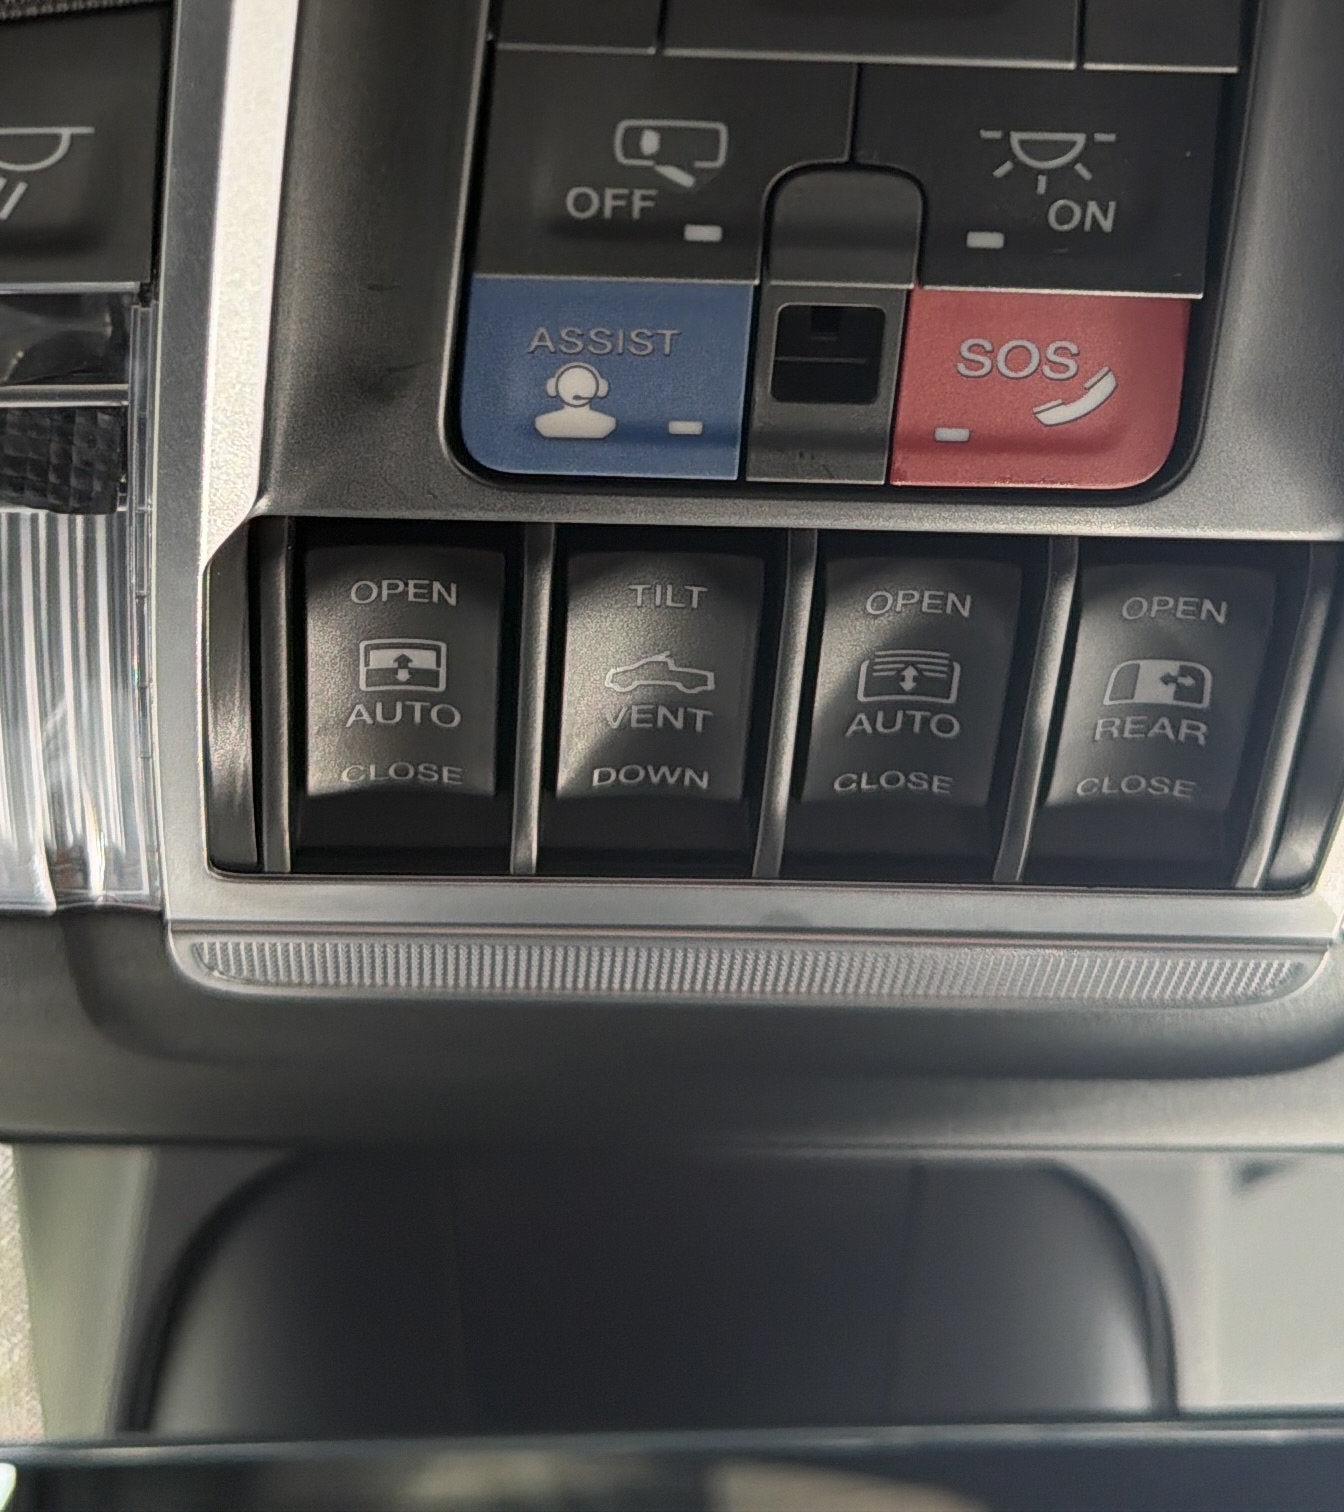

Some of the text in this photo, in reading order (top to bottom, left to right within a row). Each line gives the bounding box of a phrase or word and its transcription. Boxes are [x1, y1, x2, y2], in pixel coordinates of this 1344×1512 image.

[565, 187, 657, 219] OFF
[1048, 200, 1115, 232] ON
[528, 327, 681, 355] ASSIST
[956, 339, 1079, 380] SOS
[350, 580, 457, 607] OPEN
[629, 584, 707, 609] TILT
[865, 590, 972, 618] OPEN
[1122, 596, 1228, 623] OPEN
[345, 701, 462, 728] AUTO
[605, 705, 714, 732] VENT
[845, 710, 960, 738] AUTO
[1094, 716, 1208, 746] REAR
[341, 762, 463, 784] CLOSE
[592, 765, 709, 789] DOWN
[834, 770, 954, 794] CLOSE
[1076, 775, 1196, 799] CLOSE
